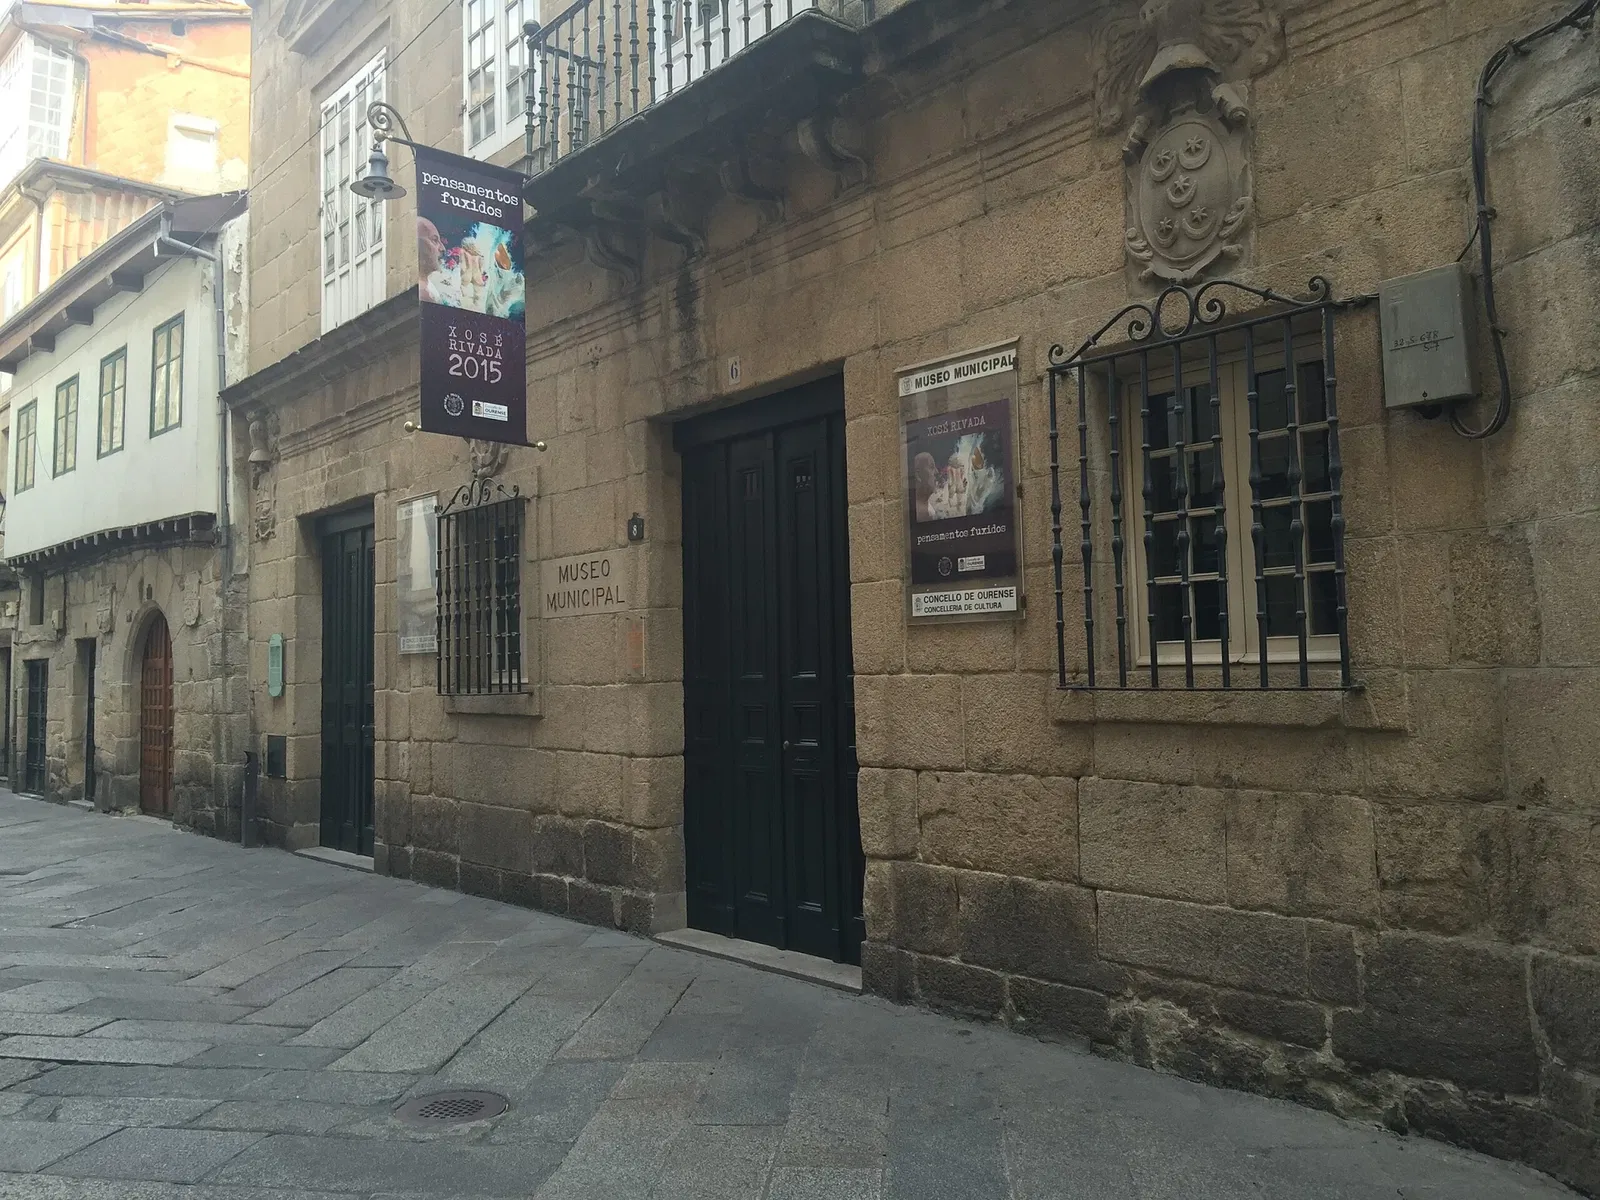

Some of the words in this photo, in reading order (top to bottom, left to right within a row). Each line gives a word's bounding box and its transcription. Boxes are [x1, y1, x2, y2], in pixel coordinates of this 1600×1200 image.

[422, 171, 519, 206] pensamentos
[441, 191, 502, 218] fuxidos
[448, 338, 503, 360] RIVADA
[448, 353, 502, 384] 2015
[730, 361, 738, 380] 6
[915, 370, 951, 389] MUSEO
[954, 354, 1014, 379] MUNICIPAL
[927, 421, 949, 436] XOSÉ
[950, 415, 986, 432] RIVADA
[917, 529, 968, 546] pensamentos
[970, 524, 1007, 537] fuxidos
[558, 559, 611, 584] MUSEO
[546, 585, 625, 613] MUNICIPAL
[923, 593, 962, 604] CONCELLO
[964, 592, 975, 601] DE
[977, 589, 1014, 600] OURENSE
[924, 604, 962, 613] CONCELLERIA
[974, 601, 1002, 610] CULTURA
